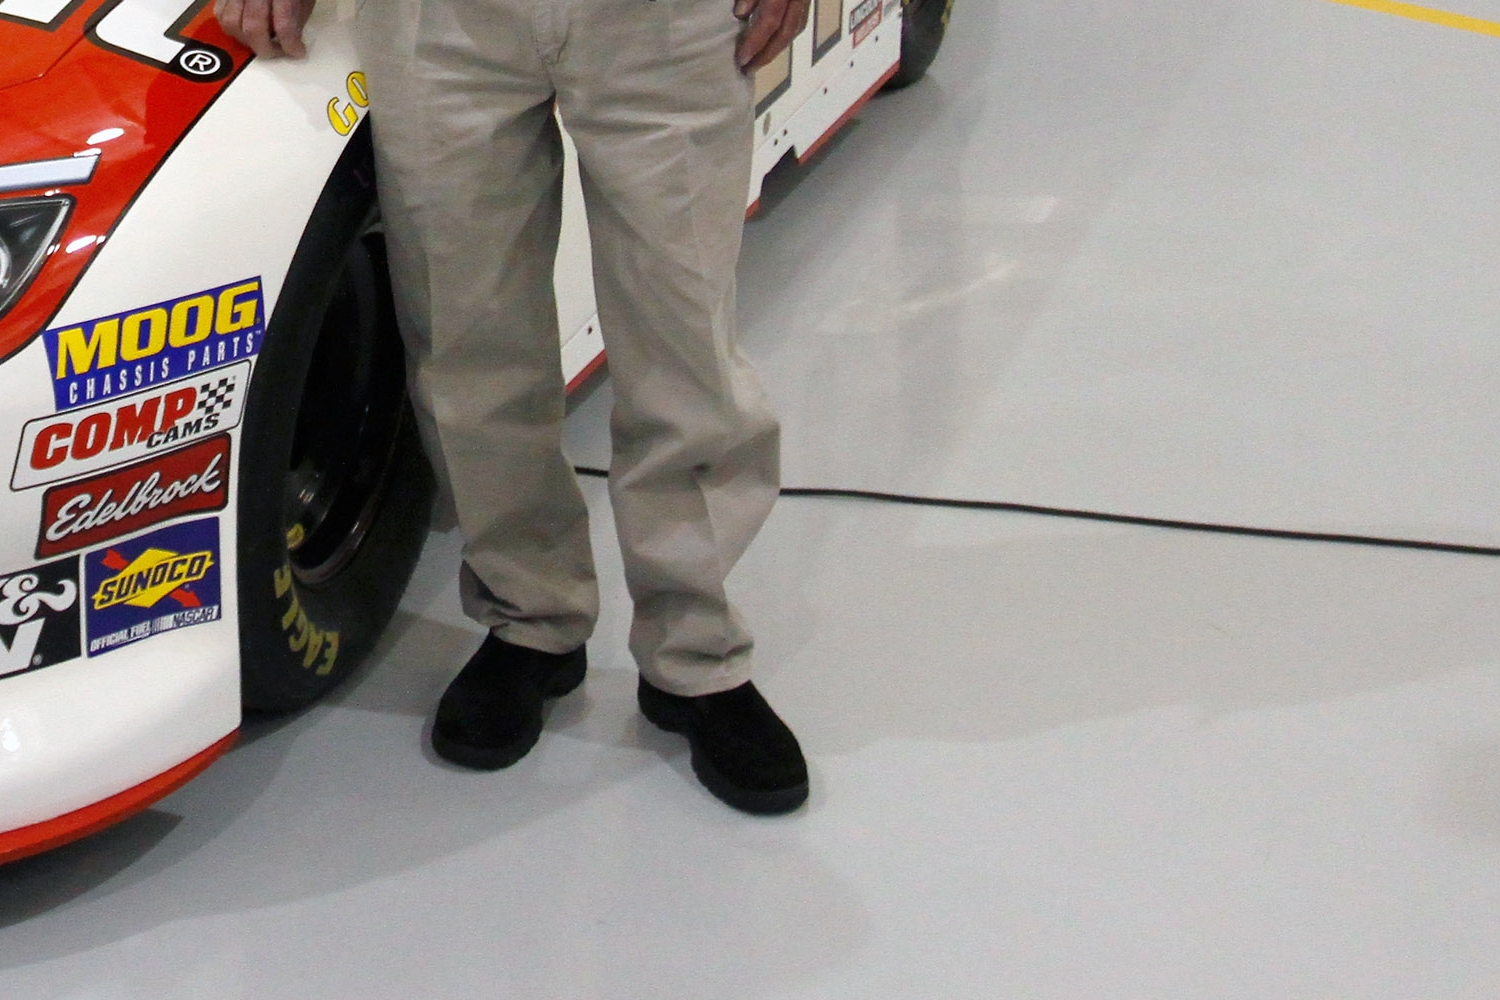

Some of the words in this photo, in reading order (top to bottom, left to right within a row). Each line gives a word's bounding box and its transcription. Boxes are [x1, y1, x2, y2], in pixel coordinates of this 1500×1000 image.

[56, 281, 259, 380] MOOG
[69, 357, 170, 404] CHASSIS
[187, 332, 255, 371] PARTS
[30, 386, 197, 471] COMP
[146, 412, 219, 449] CAMS
[46, 452, 222, 541] Edelbrock
[99, 556, 208, 602] SUNOCO
[90, 629, 129, 652] OFFICIAL
[130, 620, 152, 638] FUEL
[174, 606, 218, 626] NASCAR
